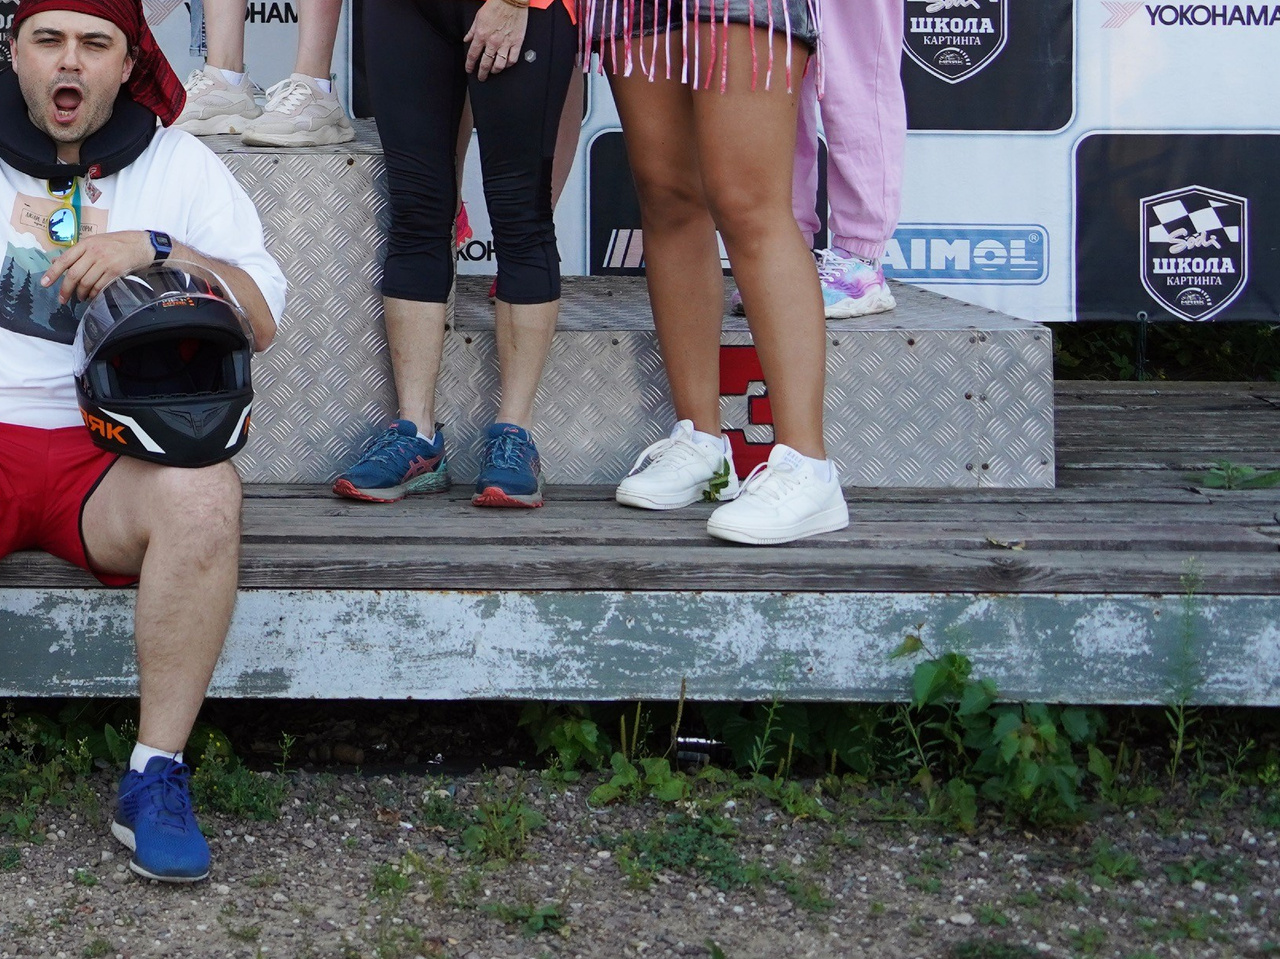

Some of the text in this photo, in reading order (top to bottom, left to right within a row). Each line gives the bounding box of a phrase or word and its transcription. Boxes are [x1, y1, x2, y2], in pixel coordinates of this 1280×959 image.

[910, 17, 994, 34] ШКОЛА
[923, 35, 981, 45] КАРТИНГА
[1152, 257, 1235, 274] ШКОЛА
[1166, 275, 1223, 286] КАРТИНГА
